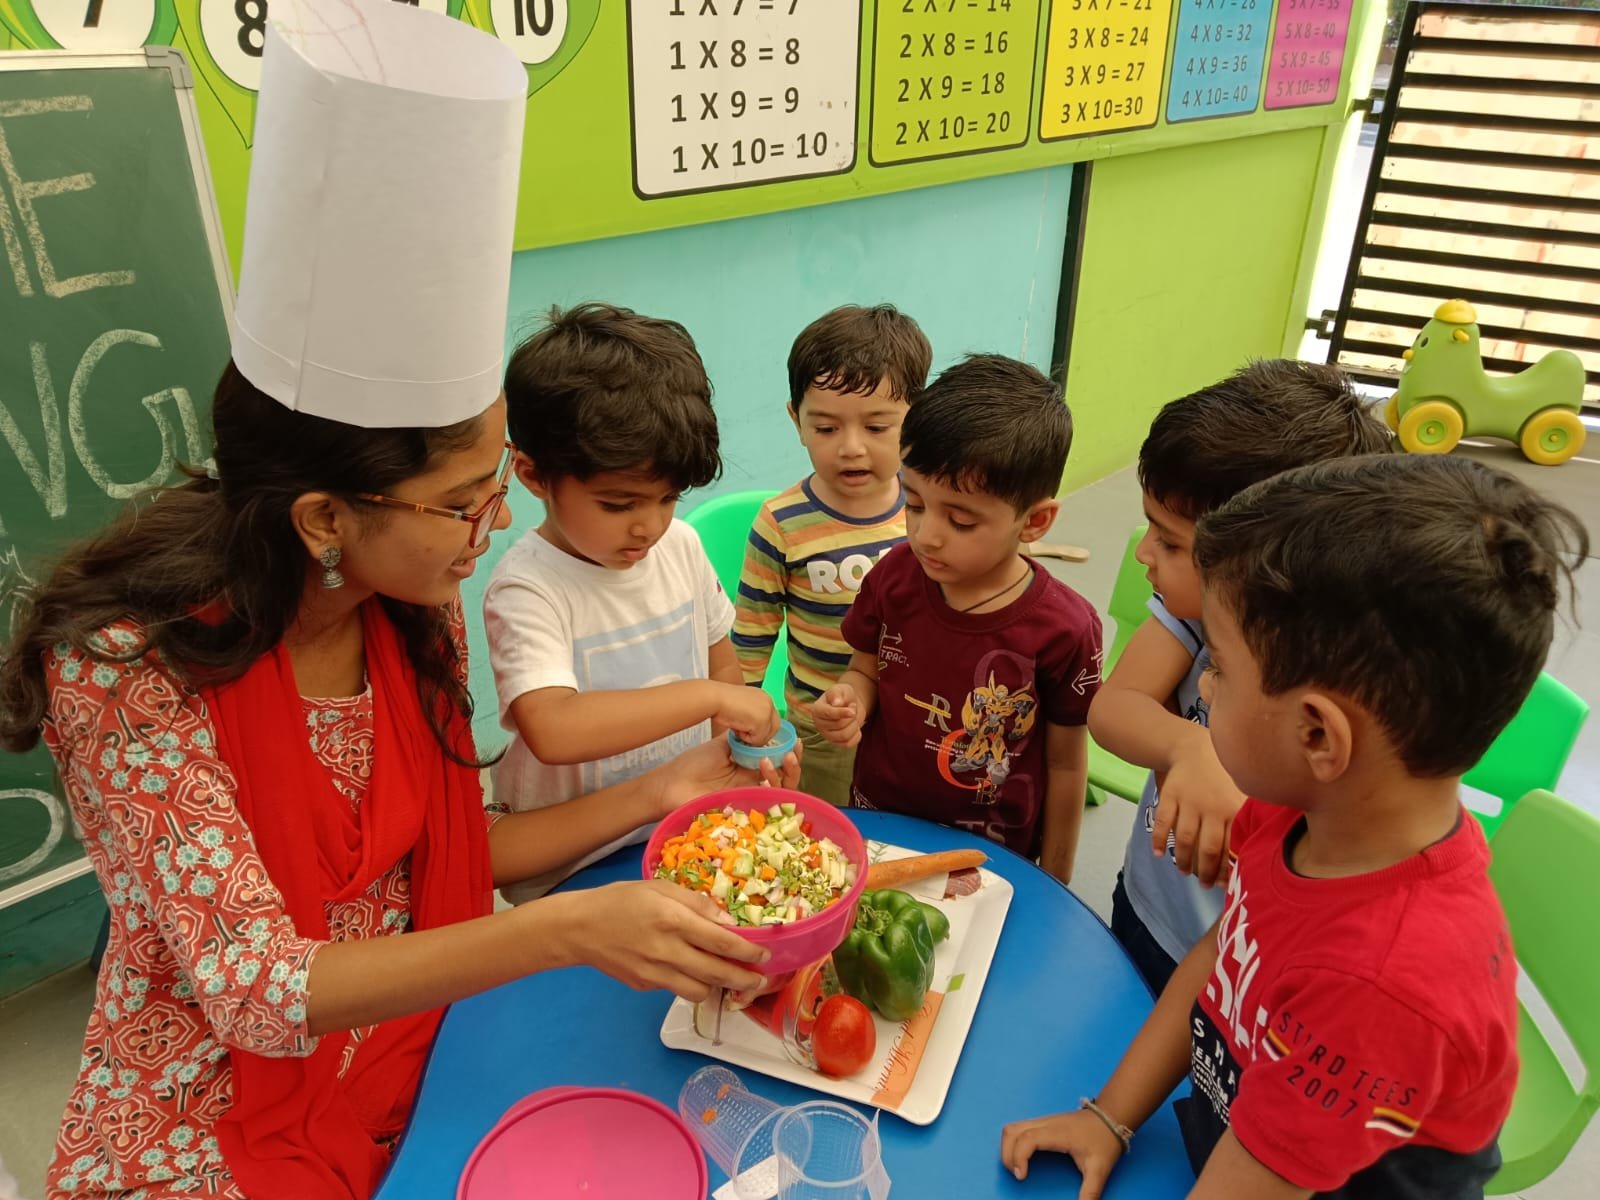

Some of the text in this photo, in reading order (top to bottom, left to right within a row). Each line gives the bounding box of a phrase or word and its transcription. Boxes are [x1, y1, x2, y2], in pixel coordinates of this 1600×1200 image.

[234, 0, 267, 57] 8
[900, 31, 1009, 58] 2 X 8 = 16
[1068, 28, 1078, 49] 3
[1084, 28, 1095, 49] X
[1101, 27, 1111, 48] 8
[1130, 26, 1149, 47] 24
[1190, 25, 1199, 42] 4
[1202, 24, 1212, 42] X
[1215, 24, 1223, 42] 8
[1236, 24, 1252, 42] 32
[670, 38, 800, 70] 1 X 8 = 8
[1186, 58, 1195, 76] 4
[1198, 57, 1208, 75] X
[1210, 56, 1218, 74] 9
[1232, 55, 1248, 73] 36
[898, 71, 1006, 103] 2 X 9 = 18
[1064, 66, 1074, 87] 3
[1080, 65, 1091, 86] X
[1096, 64, 1106, 85] 9
[1125, 61, 1146, 82] 27
[671, 87, 799, 123] 1 X 9 = 9
[1181, 91, 1190, 108] 4
[1193, 90, 1203, 107] X
[1232, 85, 1248, 103] 40
[895, 122, 907, 146] 2
[916, 120, 930, 143] X
[985, 110, 1011, 135] 20
[1060, 104, 1070, 124] 3
[1076, 102, 1087, 122] X
[672, 146, 688, 173] 1
[701, 143, 719, 170] X
[796, 132, 828, 159] 10
[807, 547, 892, 594] RO
[1286, 1064, 1358, 1119] 2007
[1352, 1069, 1418, 1106] TEES
